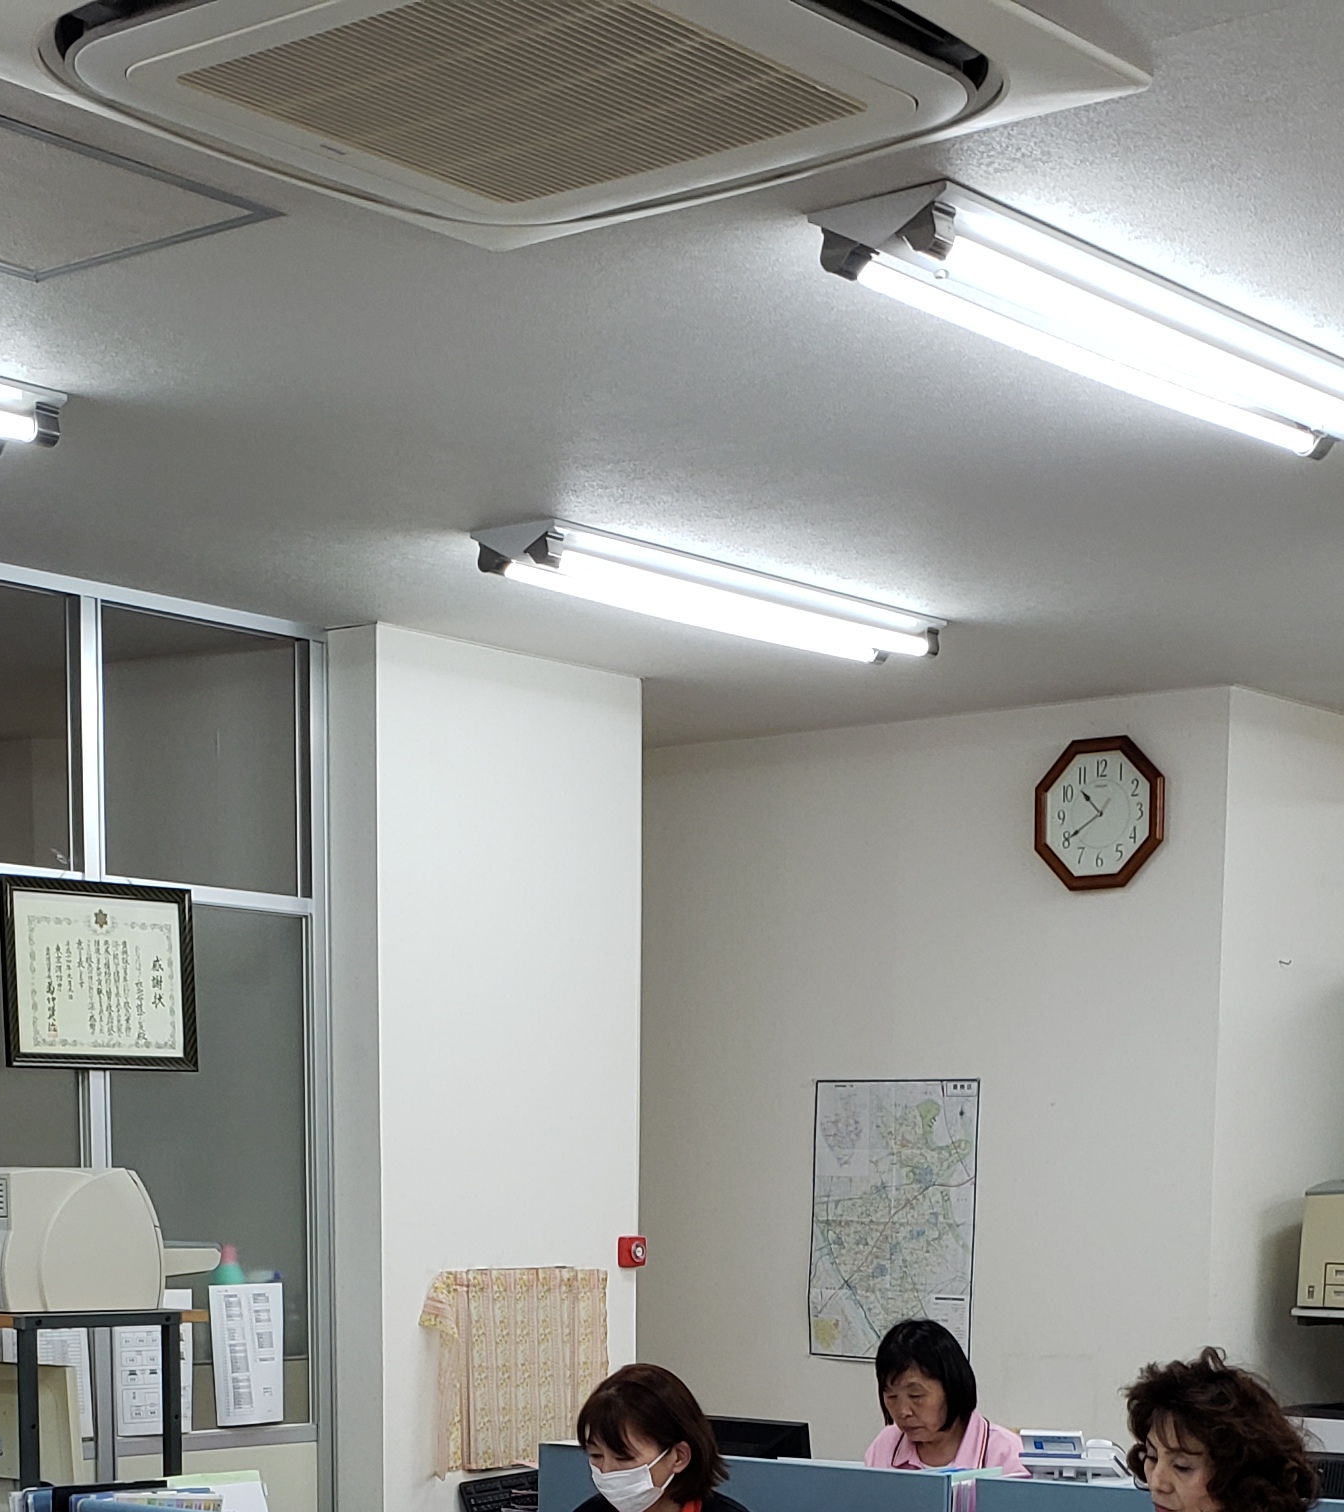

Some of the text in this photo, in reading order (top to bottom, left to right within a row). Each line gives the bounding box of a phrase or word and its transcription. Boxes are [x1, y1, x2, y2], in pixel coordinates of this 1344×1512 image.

[1078, 766, 1087, 785] 11
[1096, 759, 1107, 778] 12
[1119, 762, 1123, 781] 1
[1062, 784, 1074, 803] 10
[1131, 778, 1139, 797] 2
[1057, 810, 1066, 826] 9
[1136, 802, 1144, 821] 3
[1062, 831, 1071, 849] 8
[1129, 825, 1137, 844] 4
[1077, 847, 1085, 865] 7
[1095, 851, 1104, 868] 6
[1115, 844, 1124, 862] 5
[150, 956, 165, 1009] 感謝状
